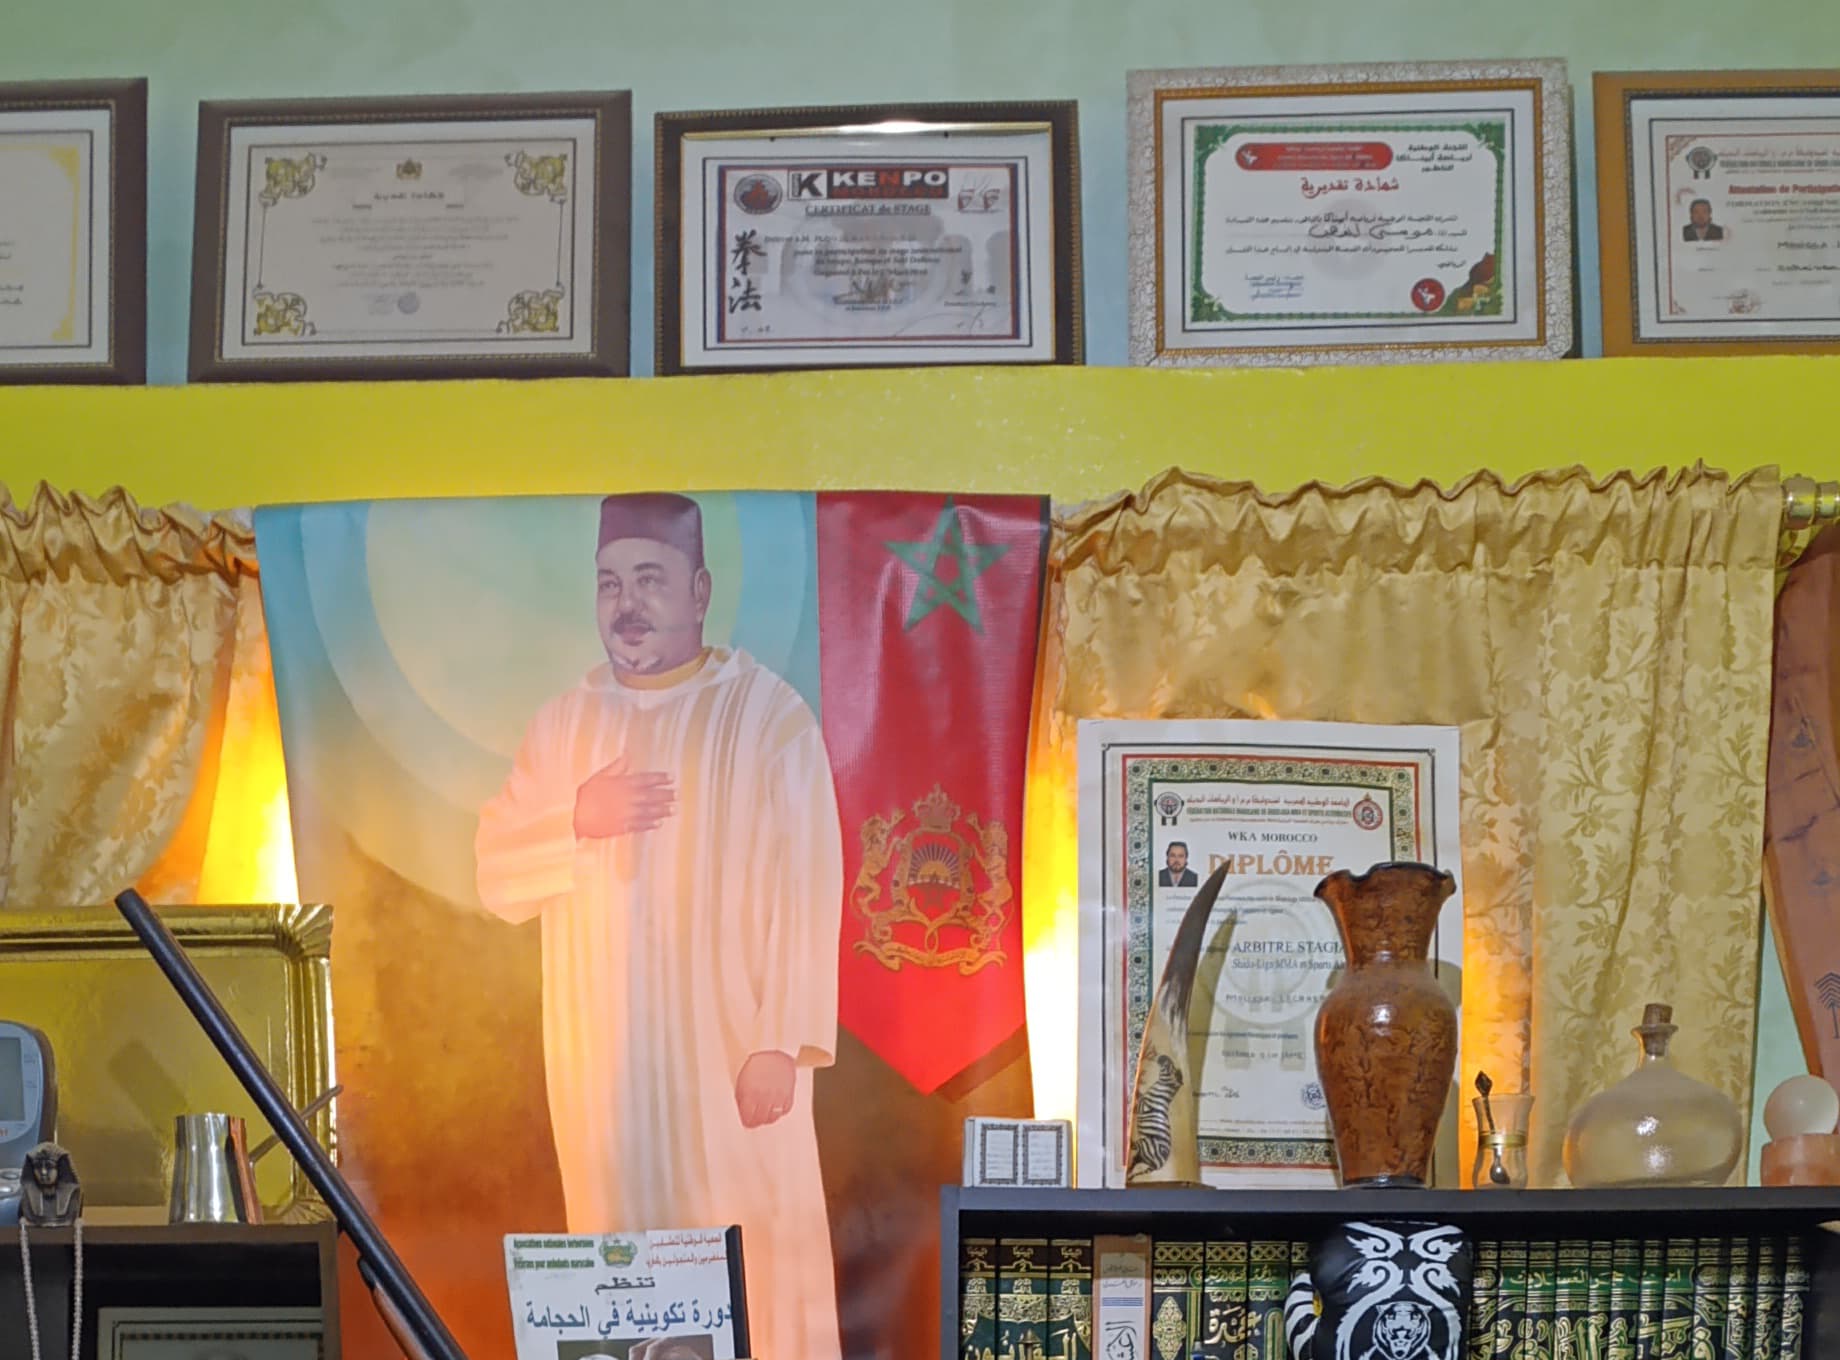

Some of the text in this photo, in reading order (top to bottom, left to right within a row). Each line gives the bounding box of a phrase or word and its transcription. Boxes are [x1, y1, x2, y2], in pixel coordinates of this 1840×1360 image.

[832, 171, 947, 187] KENPO
[1301, 176, 1400, 199] شهادة تقديرية
[804, 205, 873, 216] CERTIFICAT
[1228, 831, 1319, 843] WKA MOROCCO
[1208, 850, 1335, 876] DIPLÔME
[1233, 941, 1293, 954] ARBITRE
[526, 1299, 732, 1338] دورة تكوينية في الحجامة
